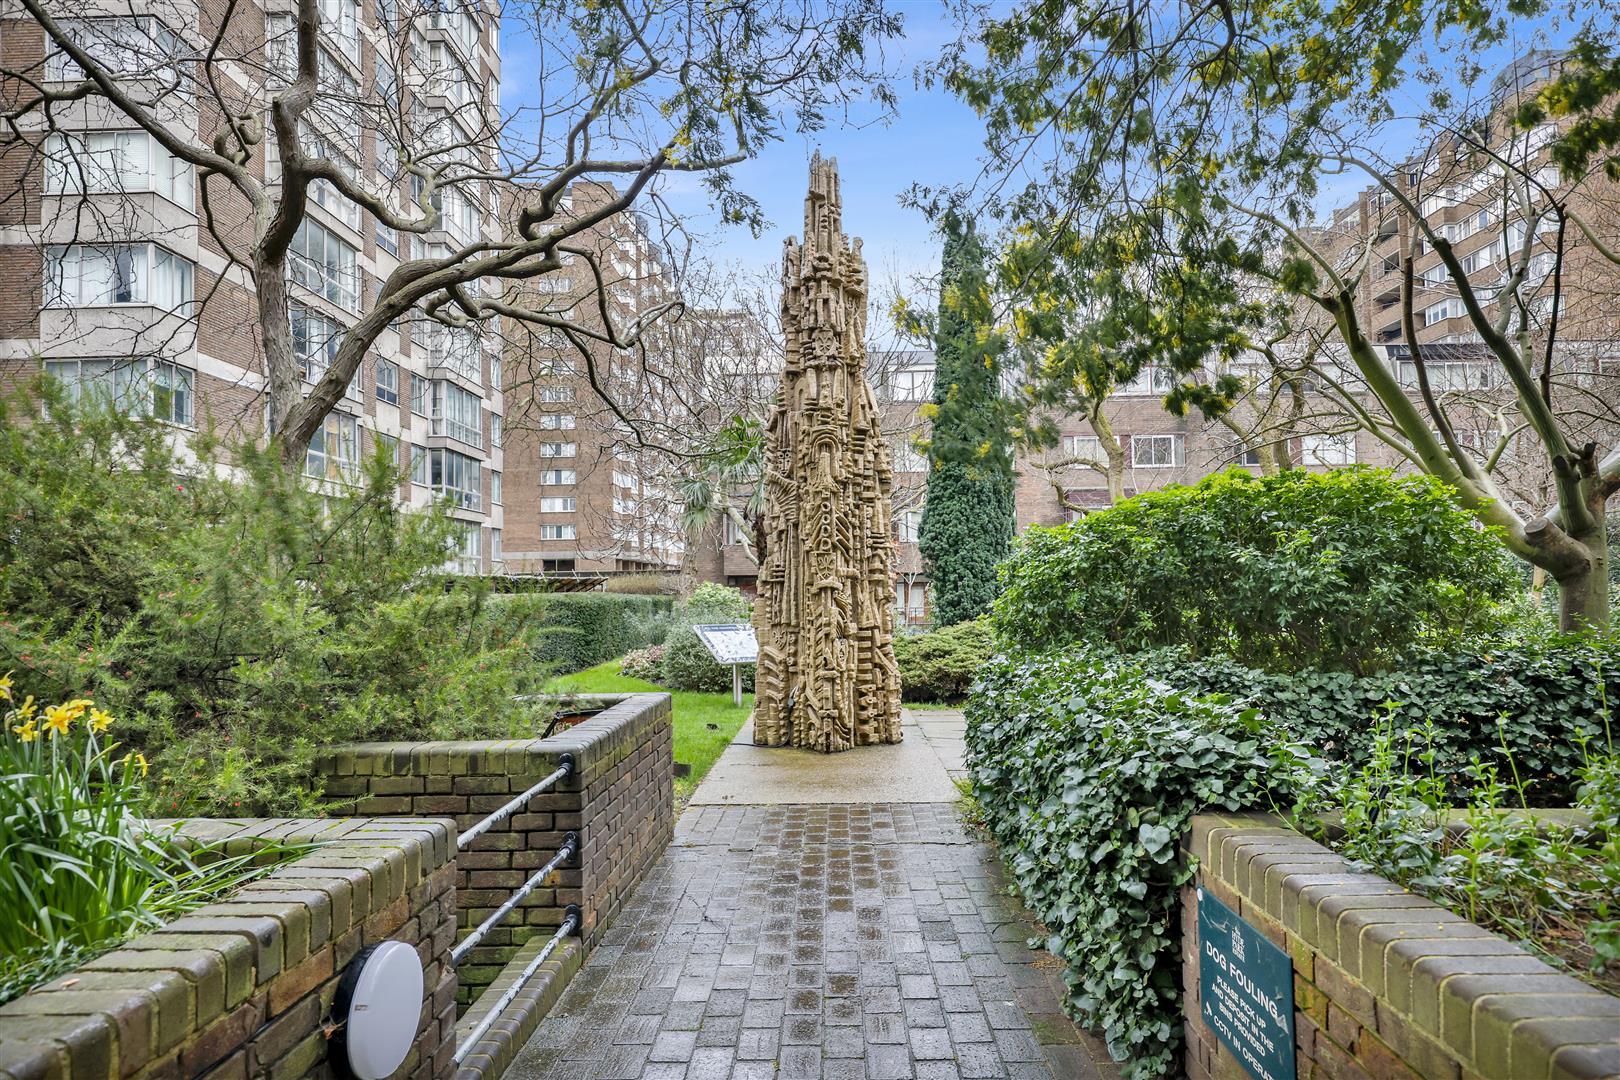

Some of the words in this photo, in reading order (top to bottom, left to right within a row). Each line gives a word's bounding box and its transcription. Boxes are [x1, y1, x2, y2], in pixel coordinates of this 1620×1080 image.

[1206, 940, 1227, 971] DOG
[1229, 962, 1278, 1020] FOULING
[1217, 975, 1239, 1004] PLEASE
[1240, 998, 1255, 1020] PICK
[1256, 1014, 1267, 1029] UP
[1212, 983, 1223, 999] AND
[1225, 995, 1250, 1027] DEPOSIT
[1251, 1022, 1259, 1037] IN
[1260, 1031, 1274, 1053] THE
[1214, 1015, 1231, 1040] CCTV
[1233, 1035, 1241, 1051] IN
[1219, 1001, 1232, 1022] BINS
[1234, 1017, 1266, 1057] PROVIDED
